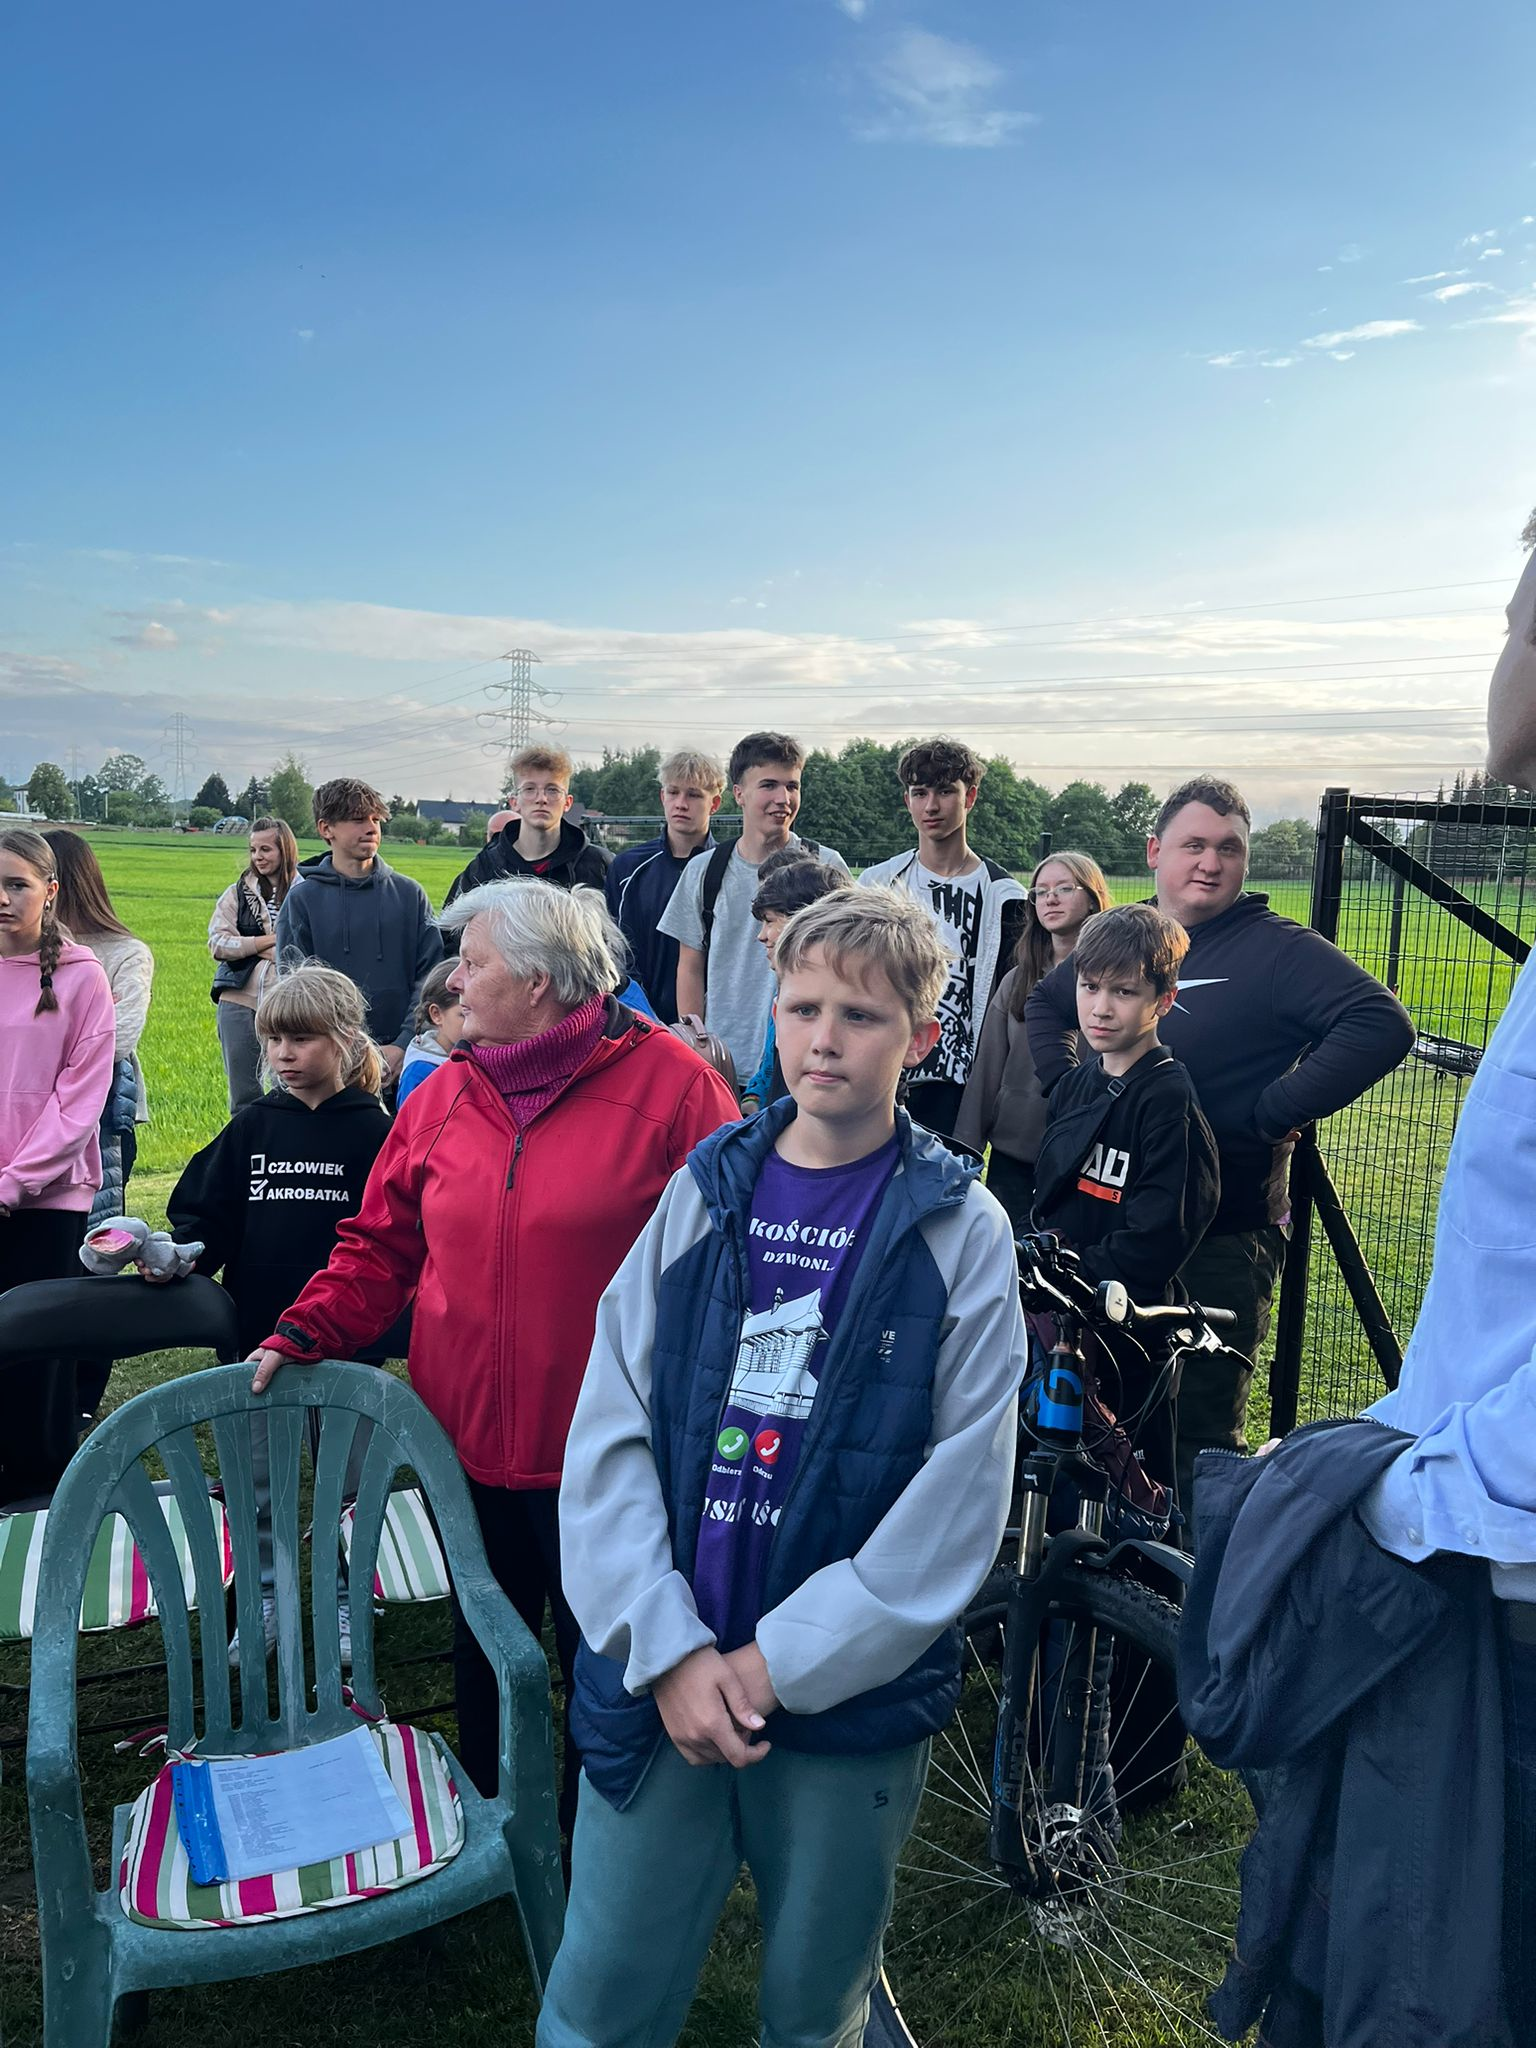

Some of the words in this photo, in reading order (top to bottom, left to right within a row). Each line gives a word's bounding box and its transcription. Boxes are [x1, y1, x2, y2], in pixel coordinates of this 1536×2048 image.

[267, 1161, 345, 1177] CZŁOWIEK
[266, 1188, 350, 1202] AKROBATKA
[711, 1463, 743, 1476] Odbierz
